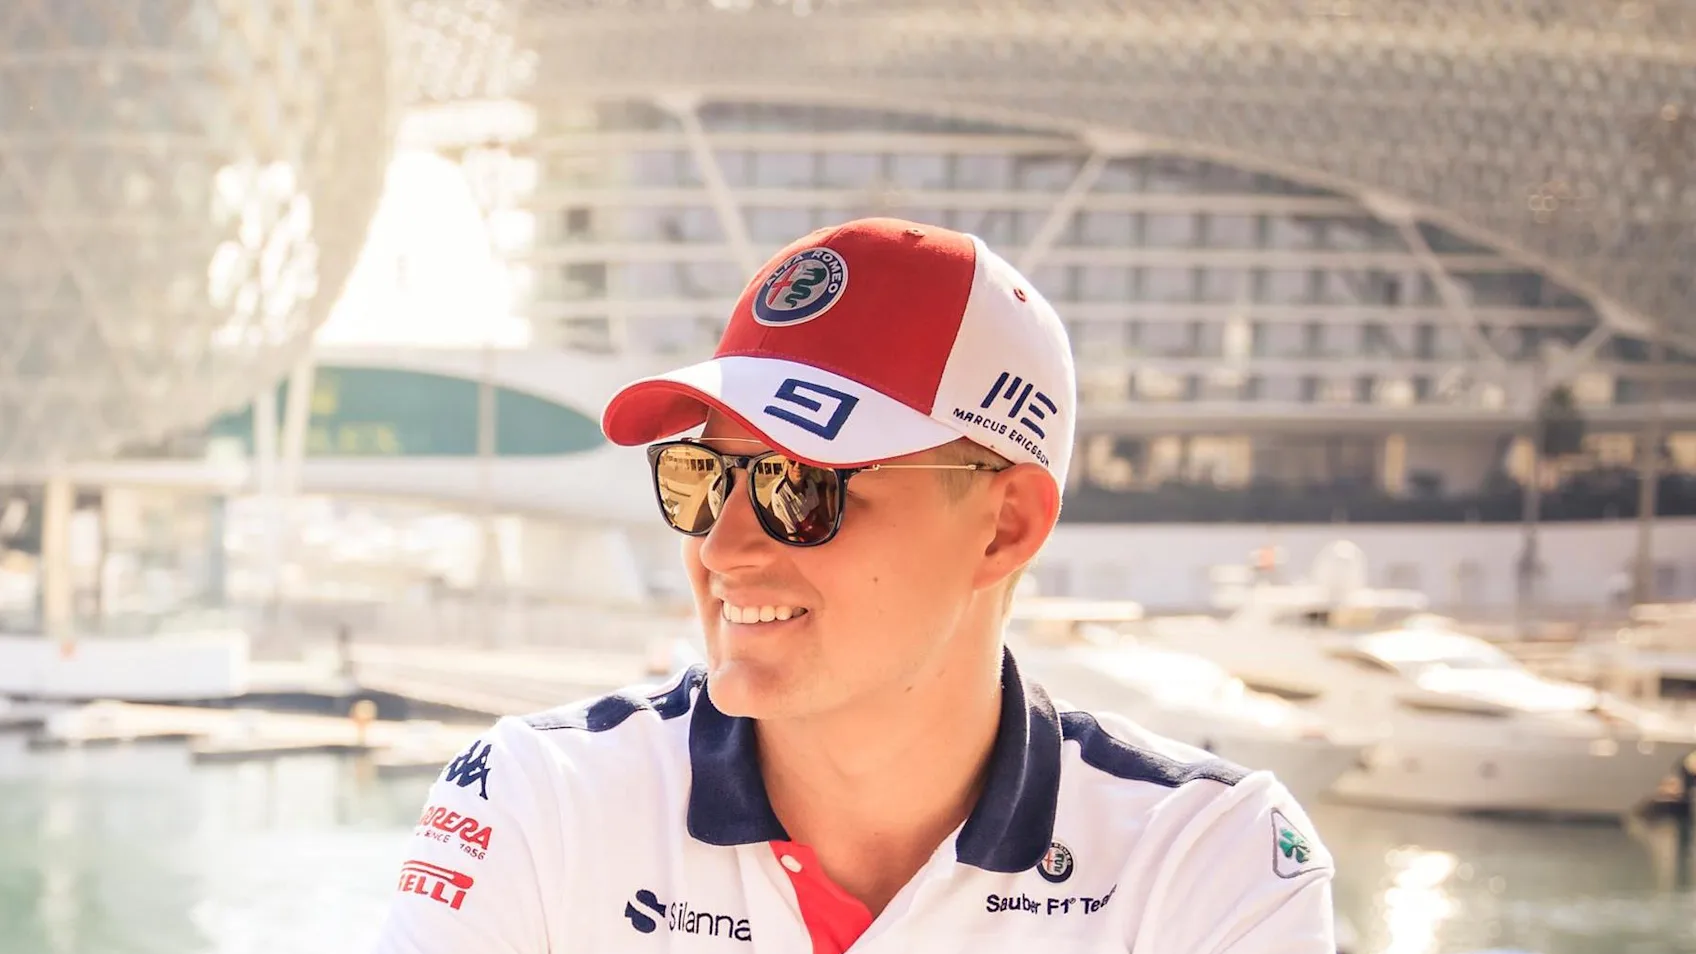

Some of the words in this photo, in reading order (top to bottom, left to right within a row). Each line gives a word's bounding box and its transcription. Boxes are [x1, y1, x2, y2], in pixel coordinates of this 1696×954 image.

[811, 249, 842, 294] ROMEO
[763, 377, 860, 441] 9
[952, 407, 1008, 435] MARCUS
[1008, 429, 1050, 468] ERICSSON
[459, 842, 487, 860] 1956
[669, 901, 752, 942] Silanna
